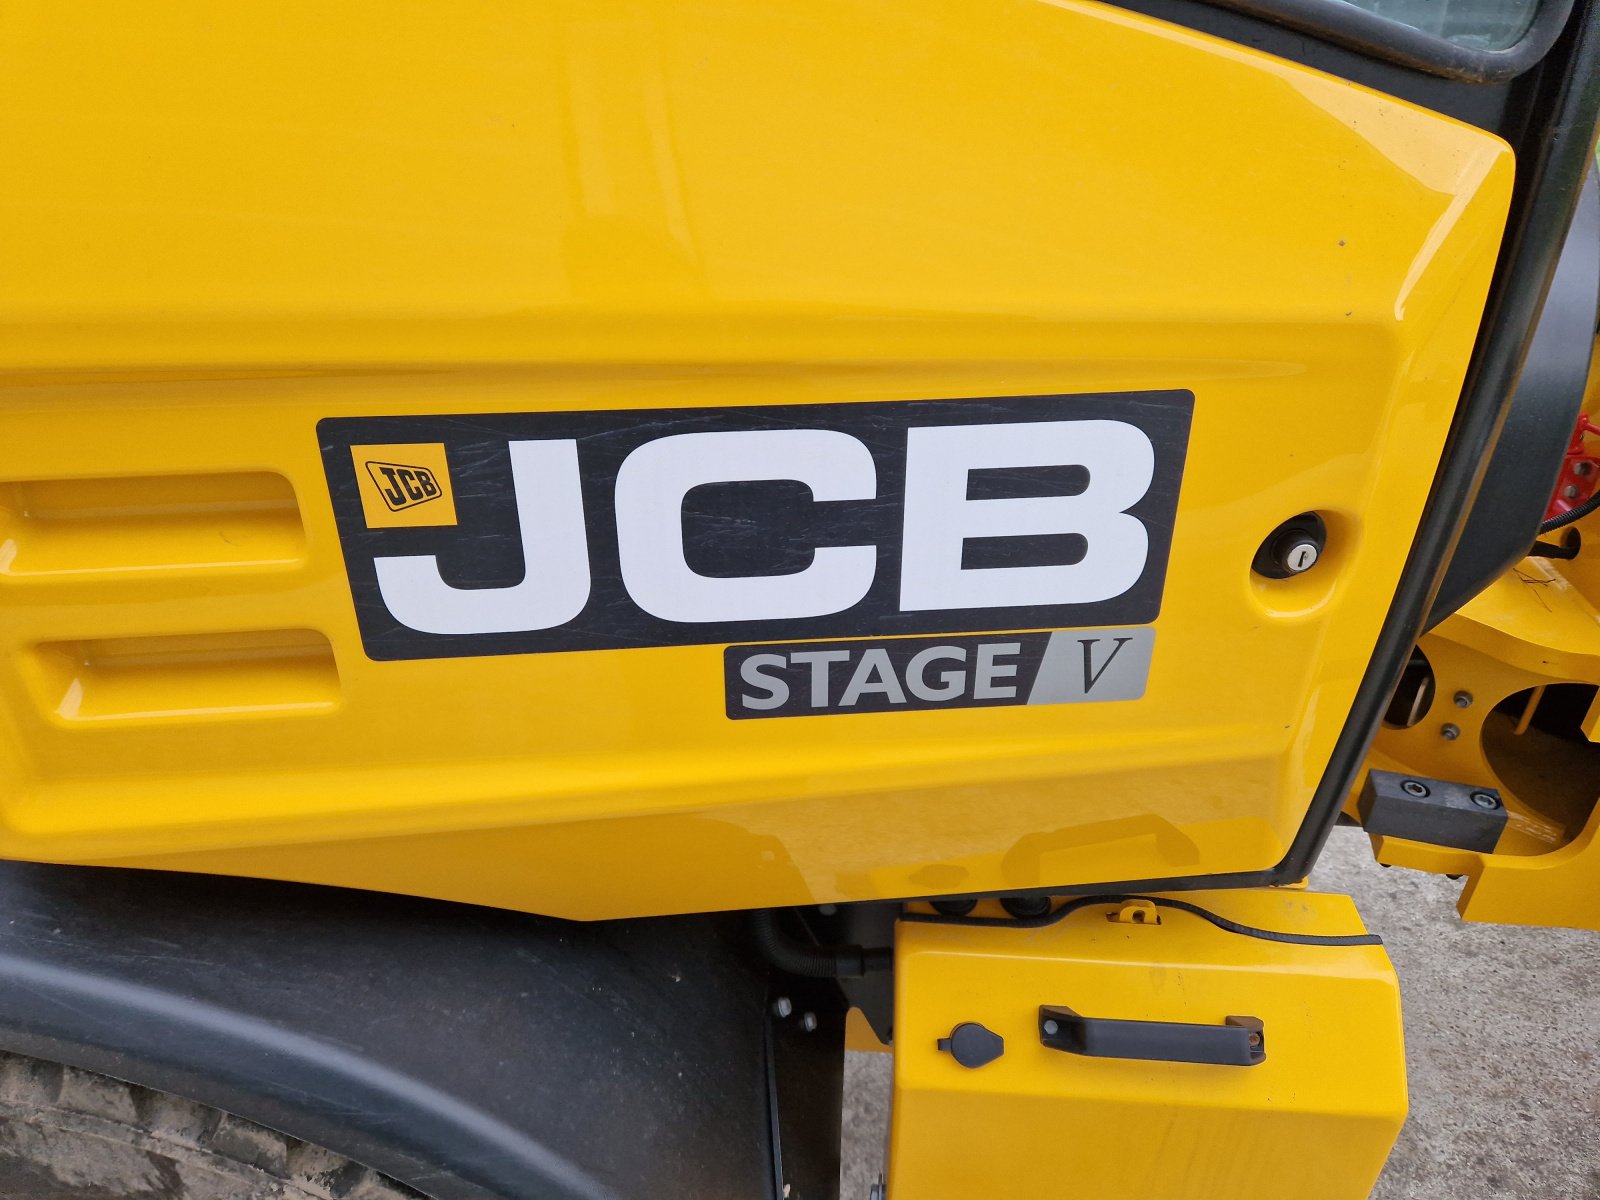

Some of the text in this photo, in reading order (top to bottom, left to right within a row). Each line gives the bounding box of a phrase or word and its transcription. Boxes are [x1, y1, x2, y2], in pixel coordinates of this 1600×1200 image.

[379, 467, 437, 506] JCB
[373, 419, 1156, 635] JCB
[740, 637, 1133, 711] STAGE V
